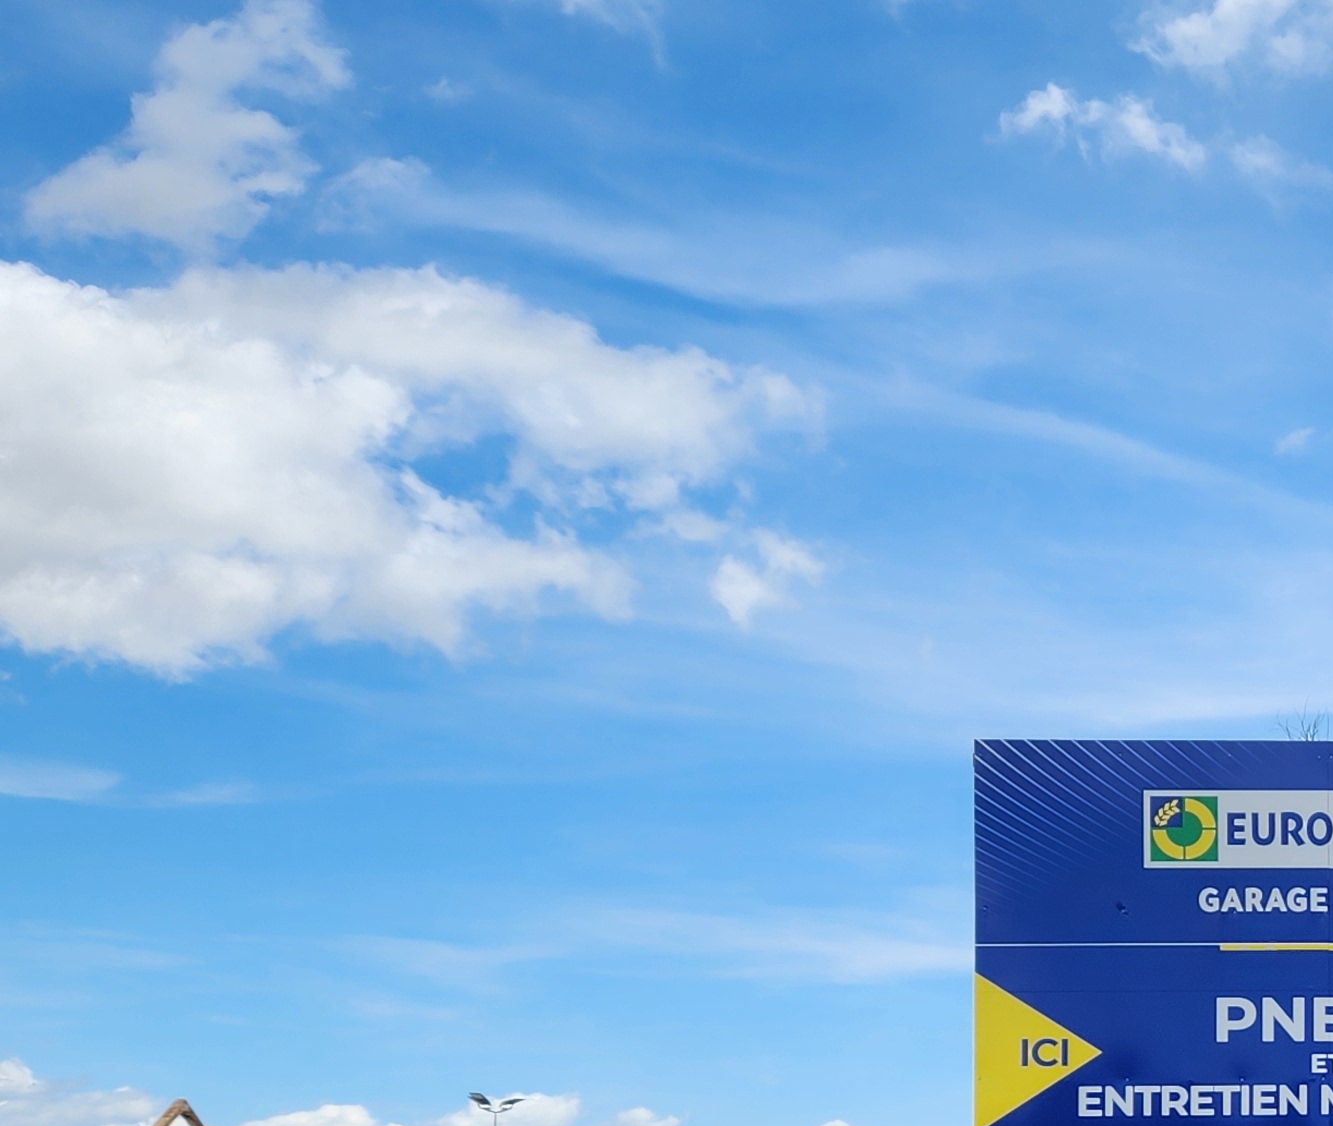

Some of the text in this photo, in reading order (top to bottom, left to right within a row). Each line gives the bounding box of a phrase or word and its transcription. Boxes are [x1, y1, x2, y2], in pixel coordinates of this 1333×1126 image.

[1199, 887, 1328, 913] GARAGE
[1021, 1038, 1069, 1067] ICI
[1077, 1084, 1308, 1117] ENTRETIEN
